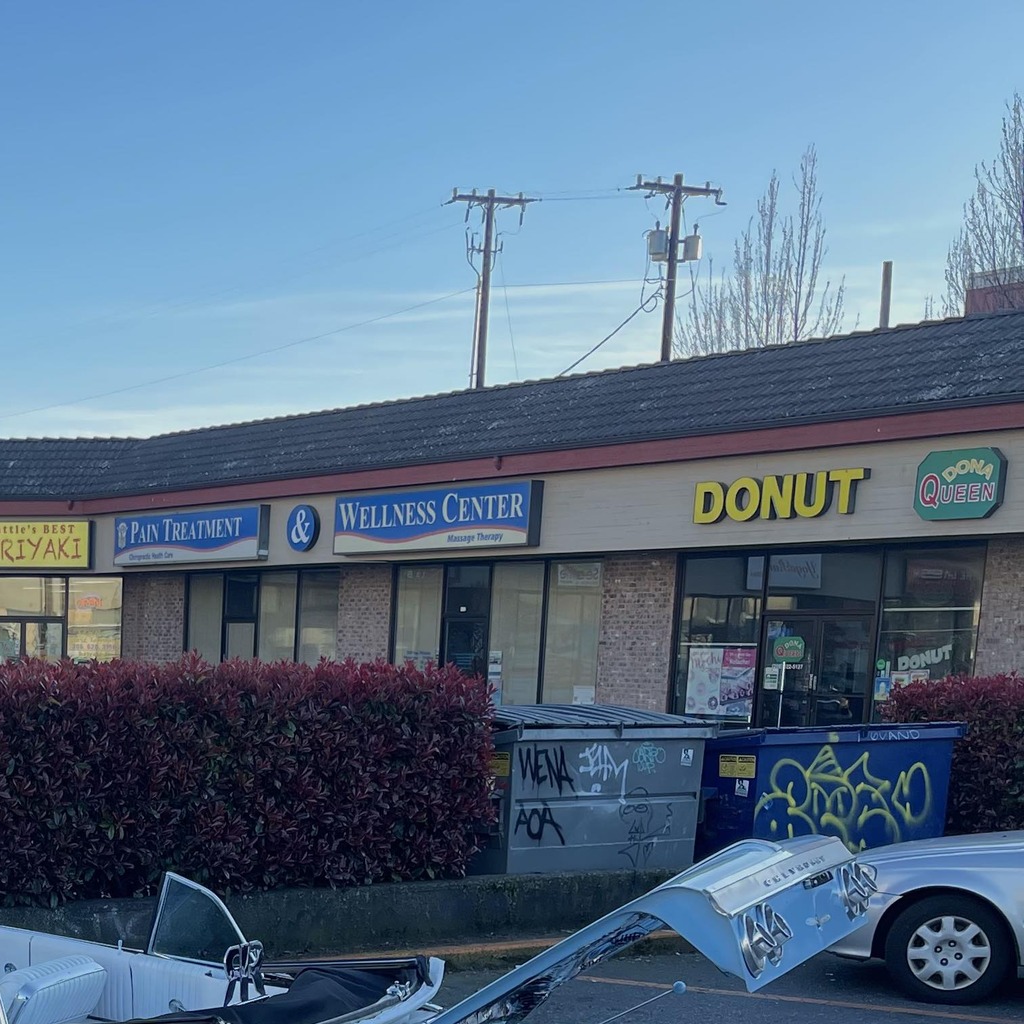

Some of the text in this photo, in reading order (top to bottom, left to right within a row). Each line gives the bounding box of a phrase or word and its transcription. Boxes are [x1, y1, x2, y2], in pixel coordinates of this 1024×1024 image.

[941, 458, 995, 483] DONA
[692, 467, 869, 525] DONUT
[919, 473, 997, 509] QUEEN
[339, 493, 524, 531] WELLNESS CENTER
[43, 524, 75, 534] BEST
[130, 516, 243, 544] PAIN TREATMENT
[291, 509, 310, 544] &
[447, 532, 503, 545] Massage Therapy
[898, 644, 953, 670] DONUT
